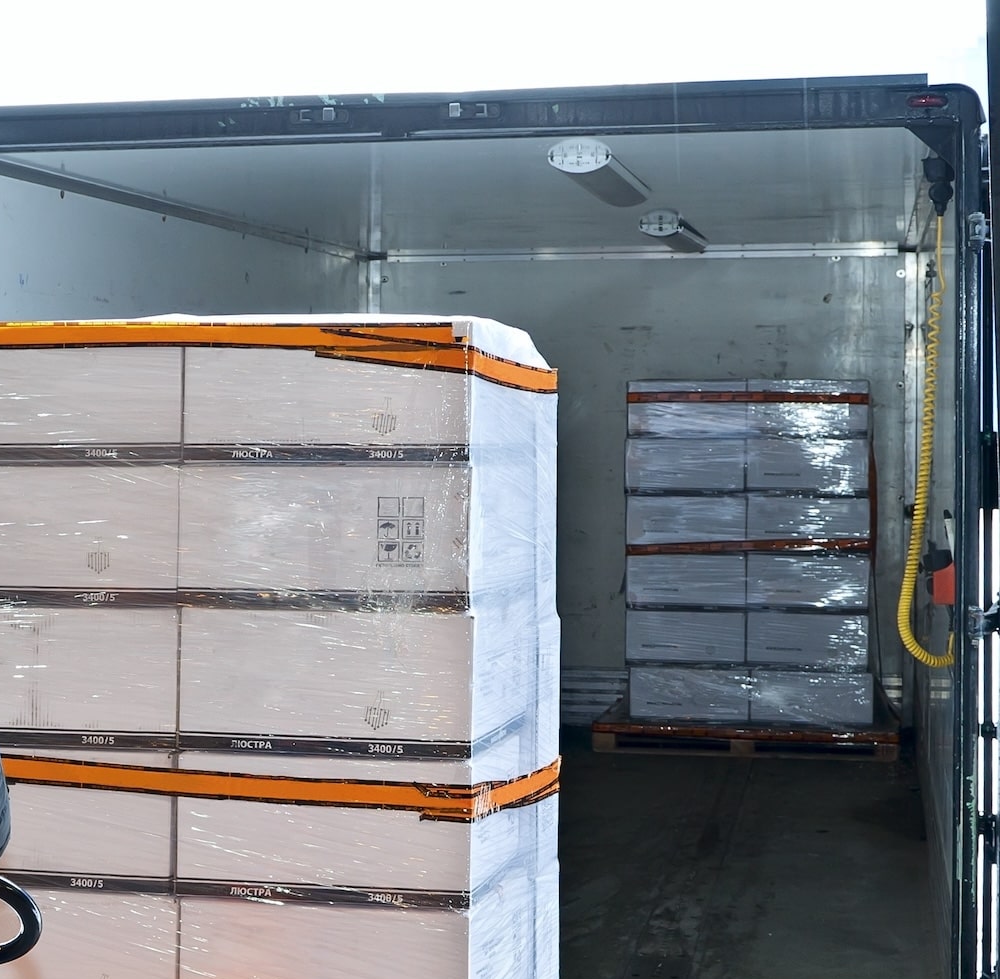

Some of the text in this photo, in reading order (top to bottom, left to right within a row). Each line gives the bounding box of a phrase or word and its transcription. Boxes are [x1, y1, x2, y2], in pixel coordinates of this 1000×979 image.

[231, 450, 404, 460] ЛЮСТРА 3400/5
[82, 592, 116, 602] 3400/5
[81, 735, 115, 745] 3400/5
[230, 739, 404, 755] ЛЮСТРА 3400/5
[70, 878, 104, 888] 3400/5
[230, 886, 272, 897] ЛЮСТРА
